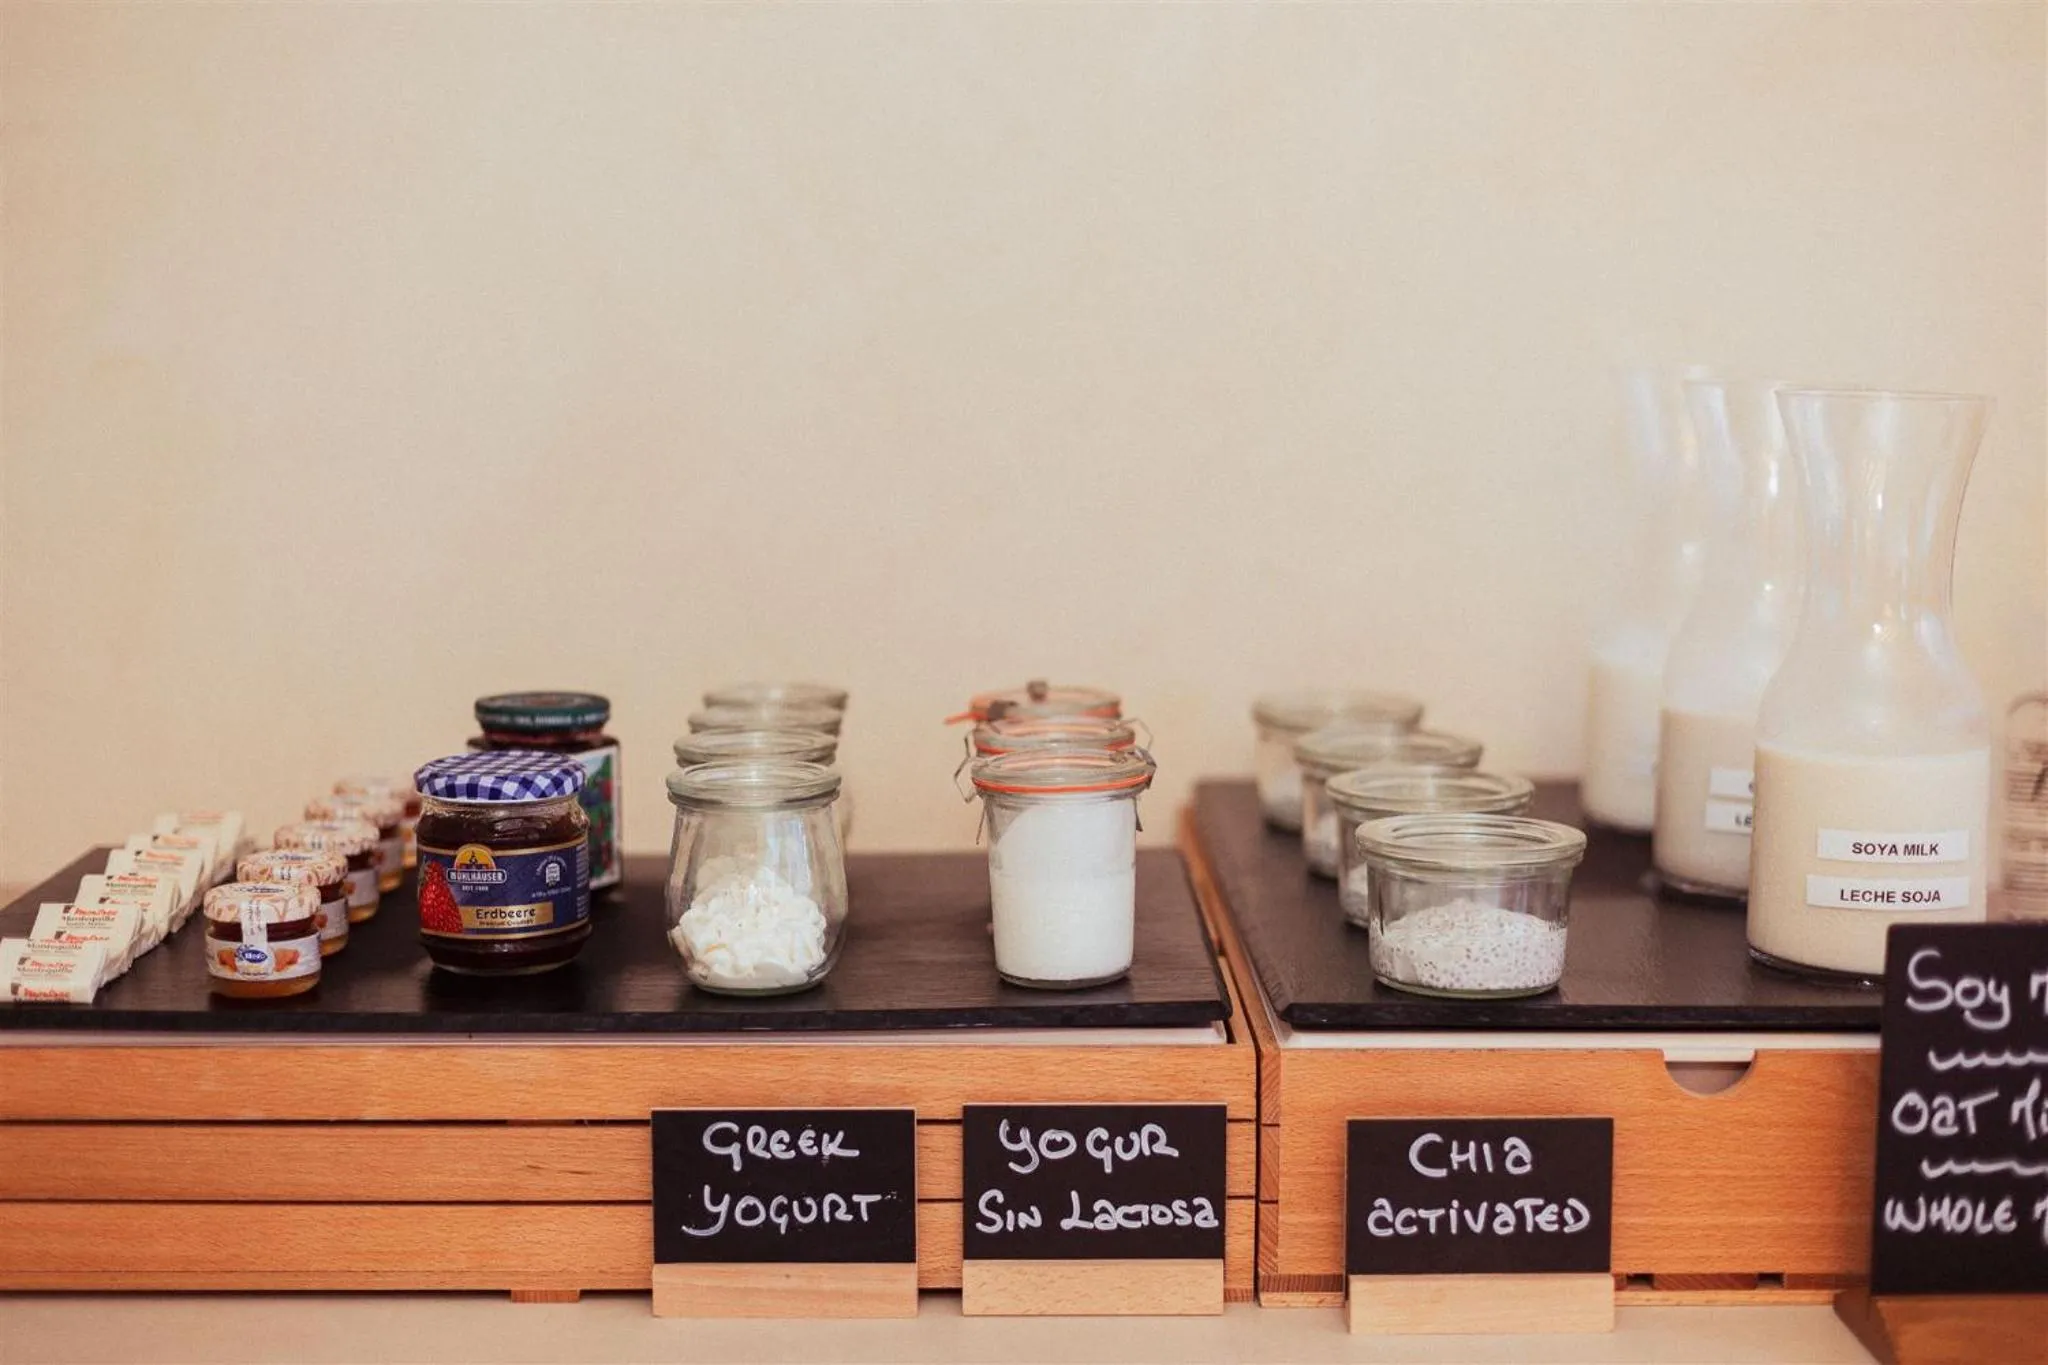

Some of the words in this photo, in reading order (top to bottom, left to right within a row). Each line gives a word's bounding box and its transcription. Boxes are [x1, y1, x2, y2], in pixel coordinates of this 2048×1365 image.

[1851, 841, 1899, 857] SOYA
[1902, 843, 1940, 857] MILK
[475, 907, 537, 920] Erdbeere
[1839, 888, 1897, 904] LECHE
[1901, 890, 1942, 904] SOJA
[1906, 949, 2011, 1030] Soy
[702, 1121, 861, 1172] GREEK
[681, 1184, 884, 1237] YOGURT
[1884, 1195, 2018, 1234] WHOLE
